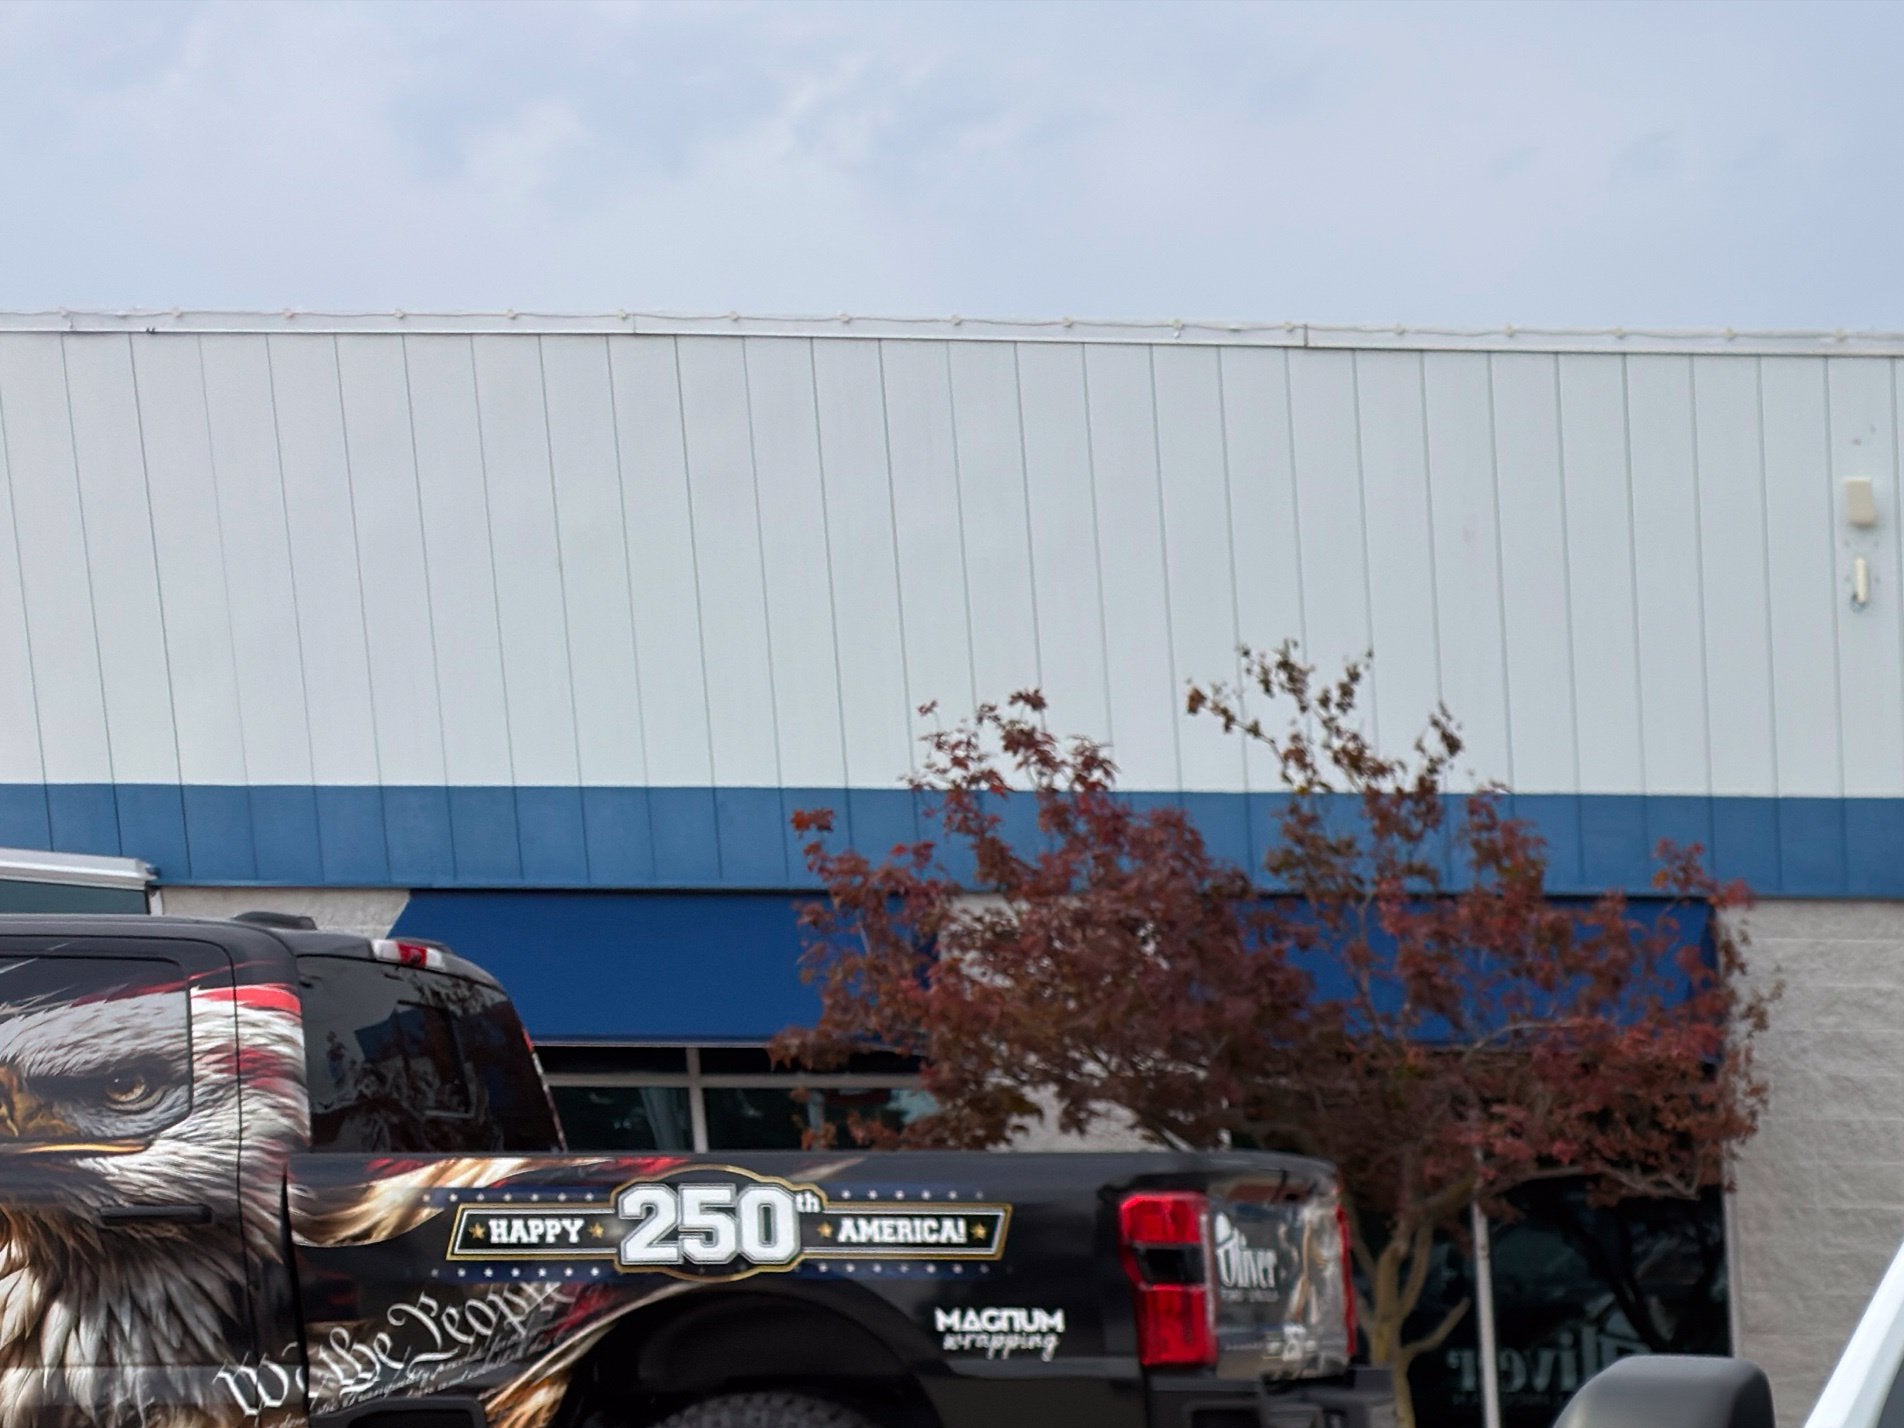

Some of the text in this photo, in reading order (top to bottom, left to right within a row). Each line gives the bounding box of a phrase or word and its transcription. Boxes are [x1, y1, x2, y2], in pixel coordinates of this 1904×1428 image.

[488, 1218, 585, 1244] HAPPY
[837, 1217, 968, 1244] AMERICA!
[934, 1307, 1065, 1333] MAGNUM
